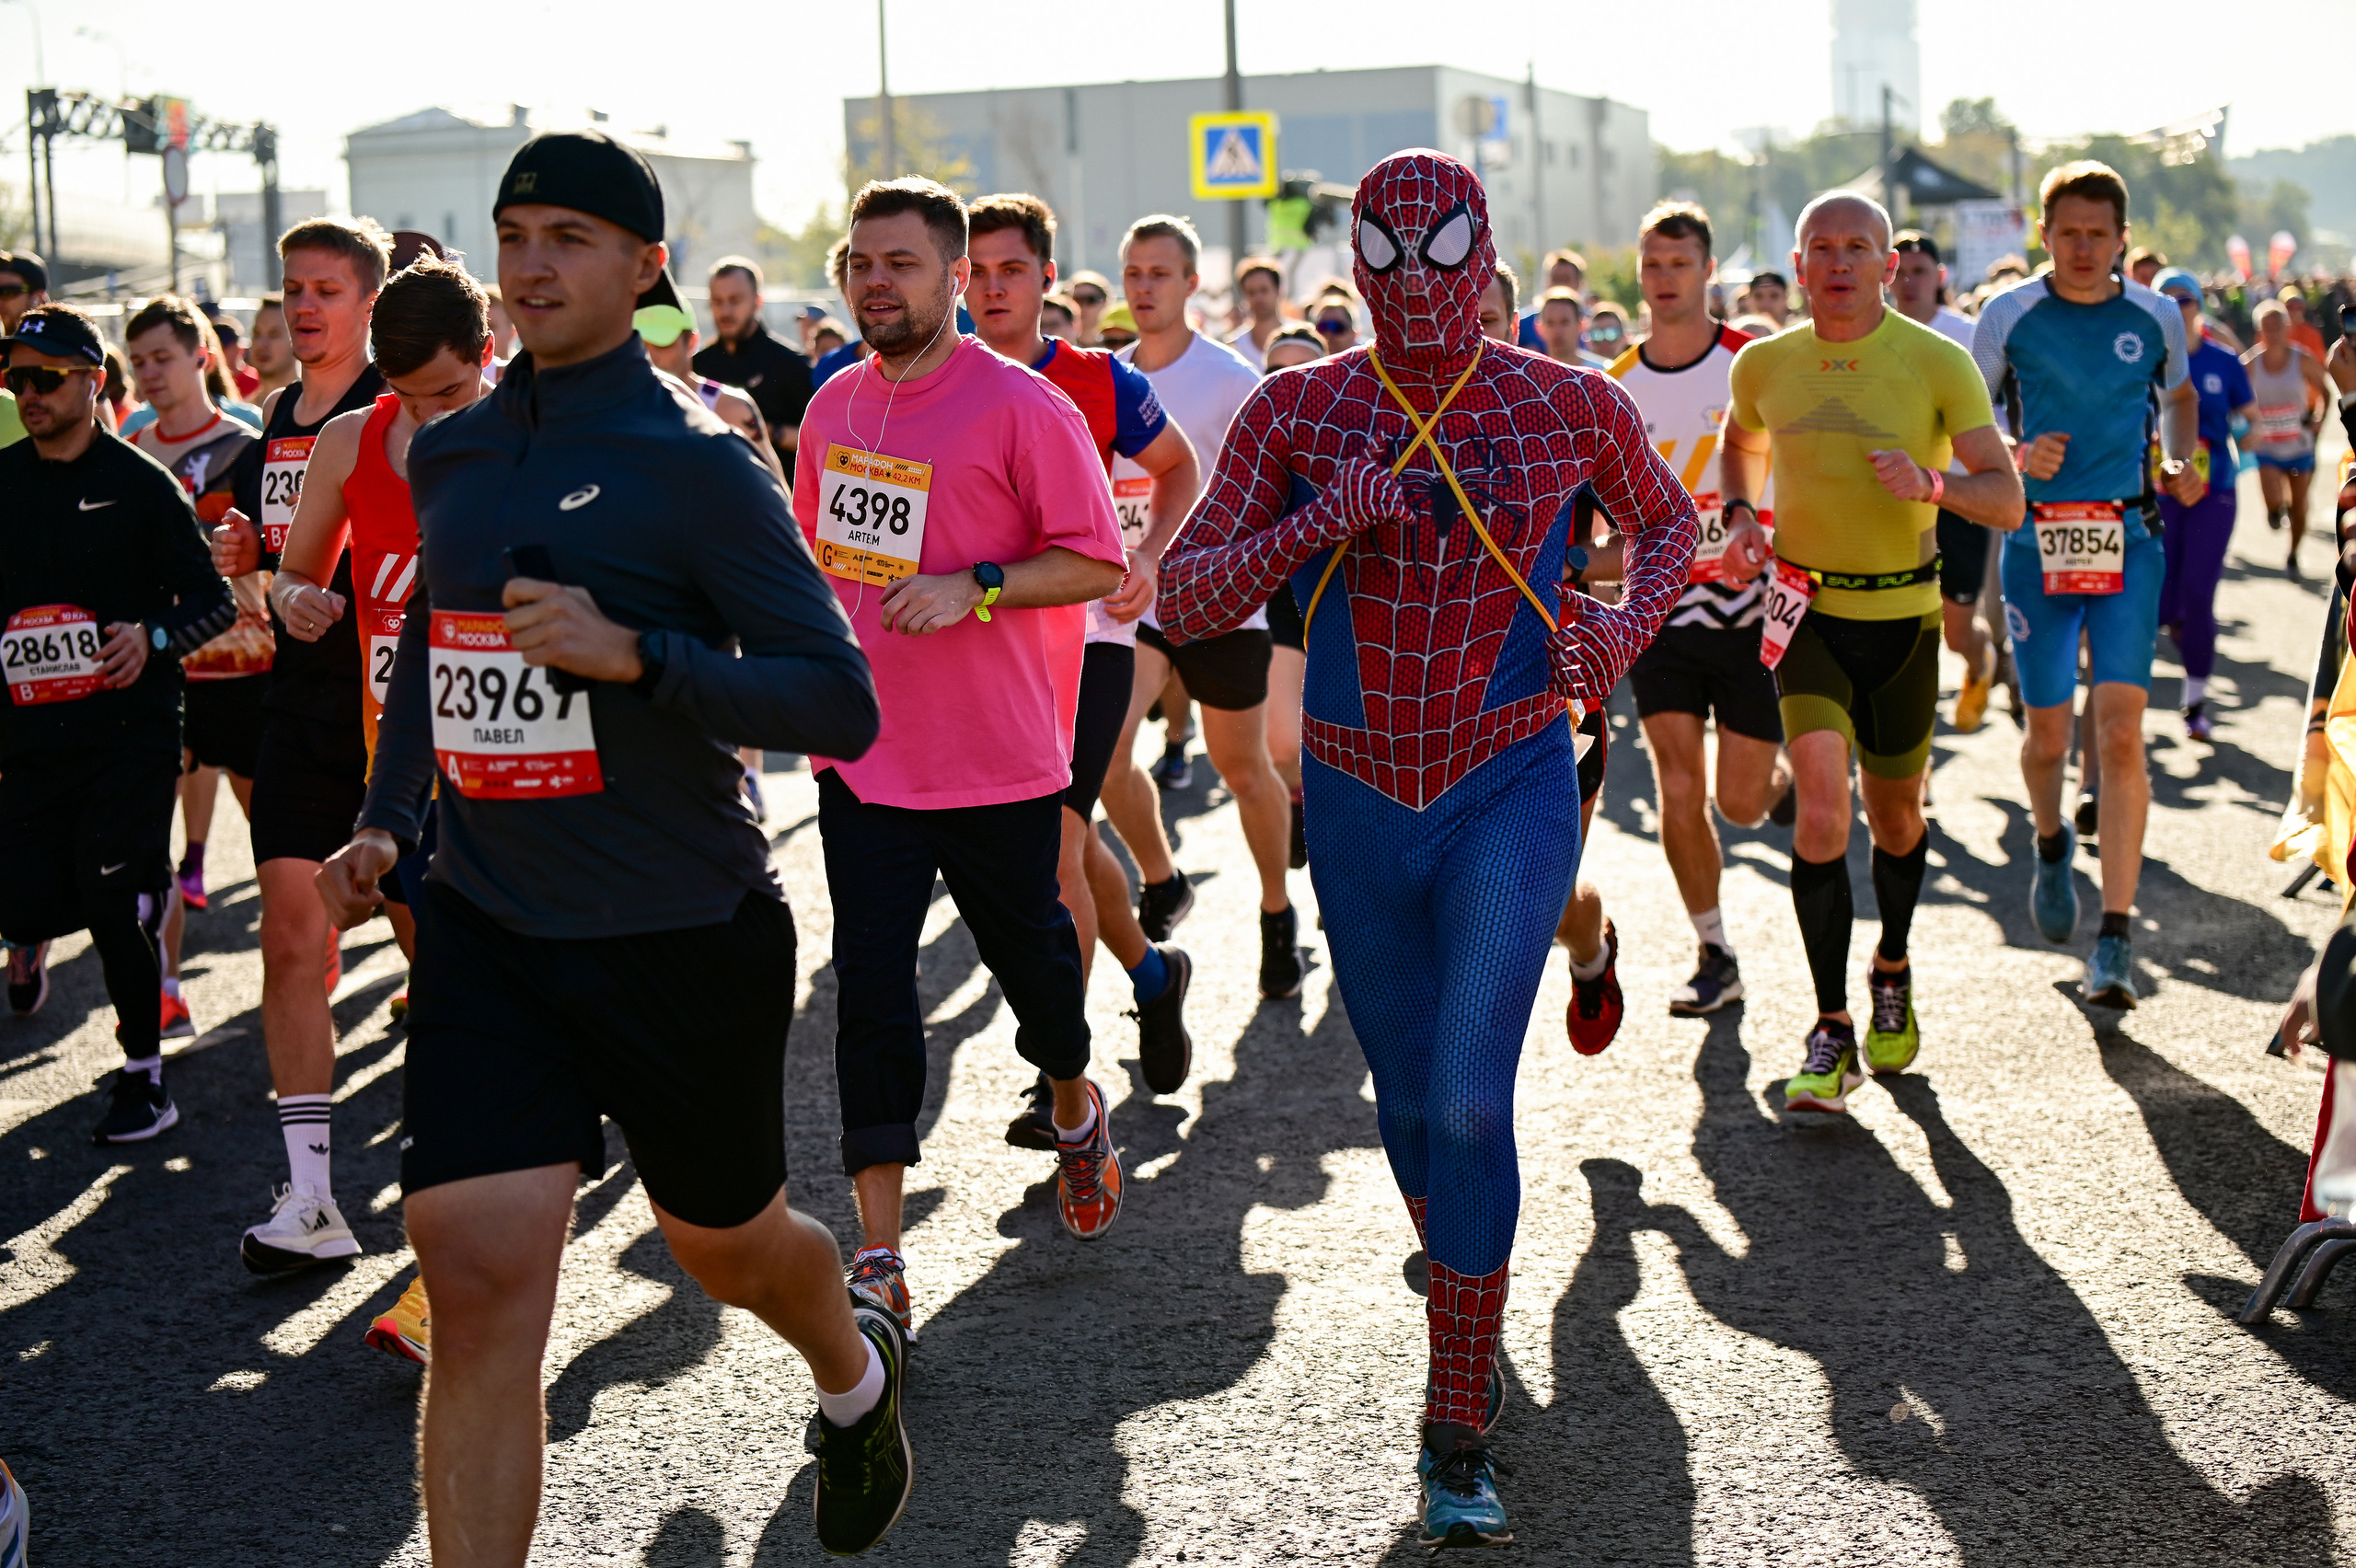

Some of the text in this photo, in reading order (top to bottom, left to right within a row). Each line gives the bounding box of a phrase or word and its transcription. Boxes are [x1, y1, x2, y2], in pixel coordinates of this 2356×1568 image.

[850, 454, 894, 471] МАРАФОН
[849, 463, 886, 478] МОСКВА
[893, 472, 908, 484] 42,2
[829, 483, 911, 536] 4398
[848, 529, 880, 546] ARTEM
[2041, 527, 2119, 555] 37854
[823, 544, 833, 567] G
[457, 619, 511, 633] МАРАФО
[458, 631, 507, 646] МОСКВА
[3, 629, 97, 669] 28618
[29, 662, 81, 676] СТАНИСЛАВ
[375, 646, 395, 683] 2
[19, 683, 35, 701] B
[473, 727, 525, 744] ПАВЕЛ
[447, 754, 464, 788] A
